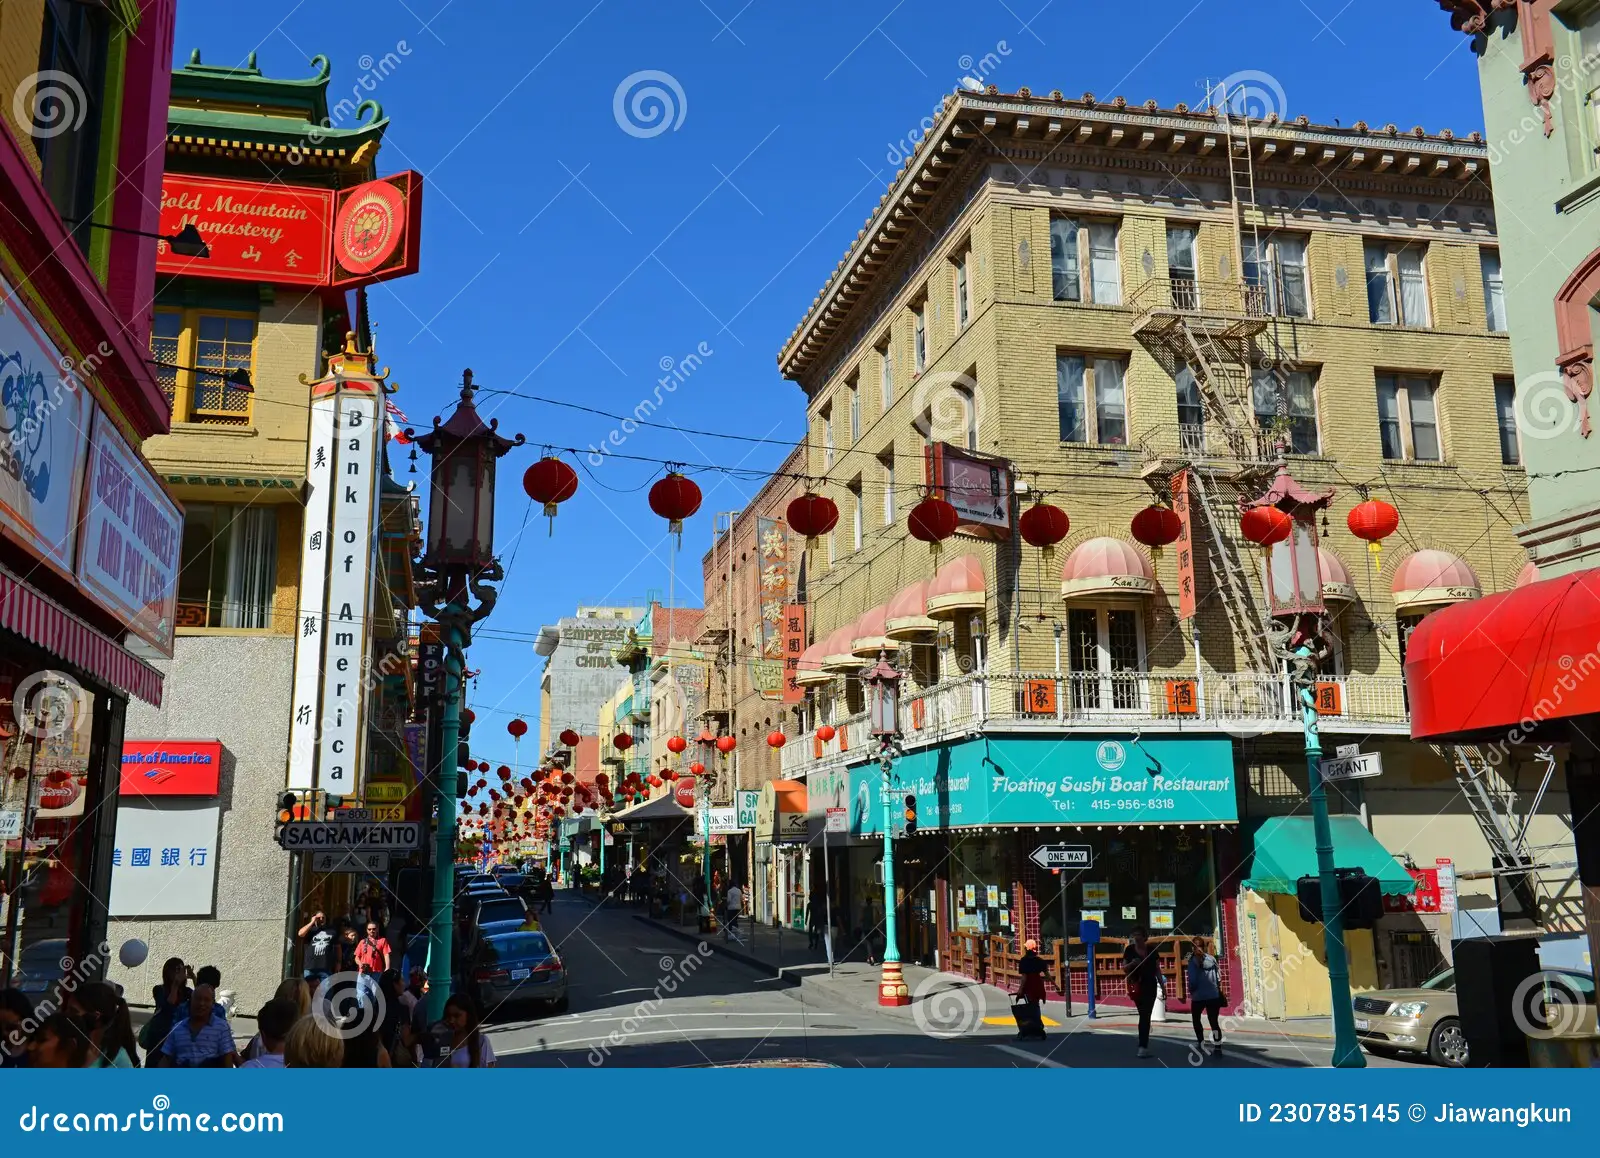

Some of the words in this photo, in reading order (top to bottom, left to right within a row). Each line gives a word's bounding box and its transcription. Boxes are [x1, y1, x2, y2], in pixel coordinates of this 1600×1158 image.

[207, 193, 308, 220] Mountain
[172, 213, 284, 244] Monastery
[345, 410, 363, 503] Bank
[97, 443, 133, 527] SERVE
[132, 484, 176, 570] YOURSELF
[96, 517, 123, 582] AND
[122, 539, 144, 599] PAY
[344, 530, 356, 573] of
[296, 446, 327, 725] 美國銀行
[1110, 576, 1140, 587] Kan's
[1446, 587, 1473, 598] Kan's
[562, 628, 626, 641] EMPRESS
[586, 642, 604, 654] OF
[575, 655, 615, 669] CHINA
[330, 602, 354, 780] America
[122, 751, 144, 764] ank
[145, 751, 159, 764] of
[160, 751, 212, 765] America
[1327, 758, 1369, 777] GRANT
[991, 776, 1057, 797] Floating
[1059, 776, 1105, 795] Sushi
[1109, 775, 1148, 793] Boat
[1152, 775, 1230, 793] Restaurant
[745, 794, 759, 808] SN
[1052, 800, 1076, 810] Tel:
[1091, 798, 1175, 810] 415-956-8318
[348, 810, 368, 820] 800
[371, 808, 401, 820] ITES
[789, 813, 809, 828] Ka
[287, 826, 416, 845] SACRAMENTO
[1047, 852, 1065, 861] ONE
[1067, 852, 1085, 861] WAY
